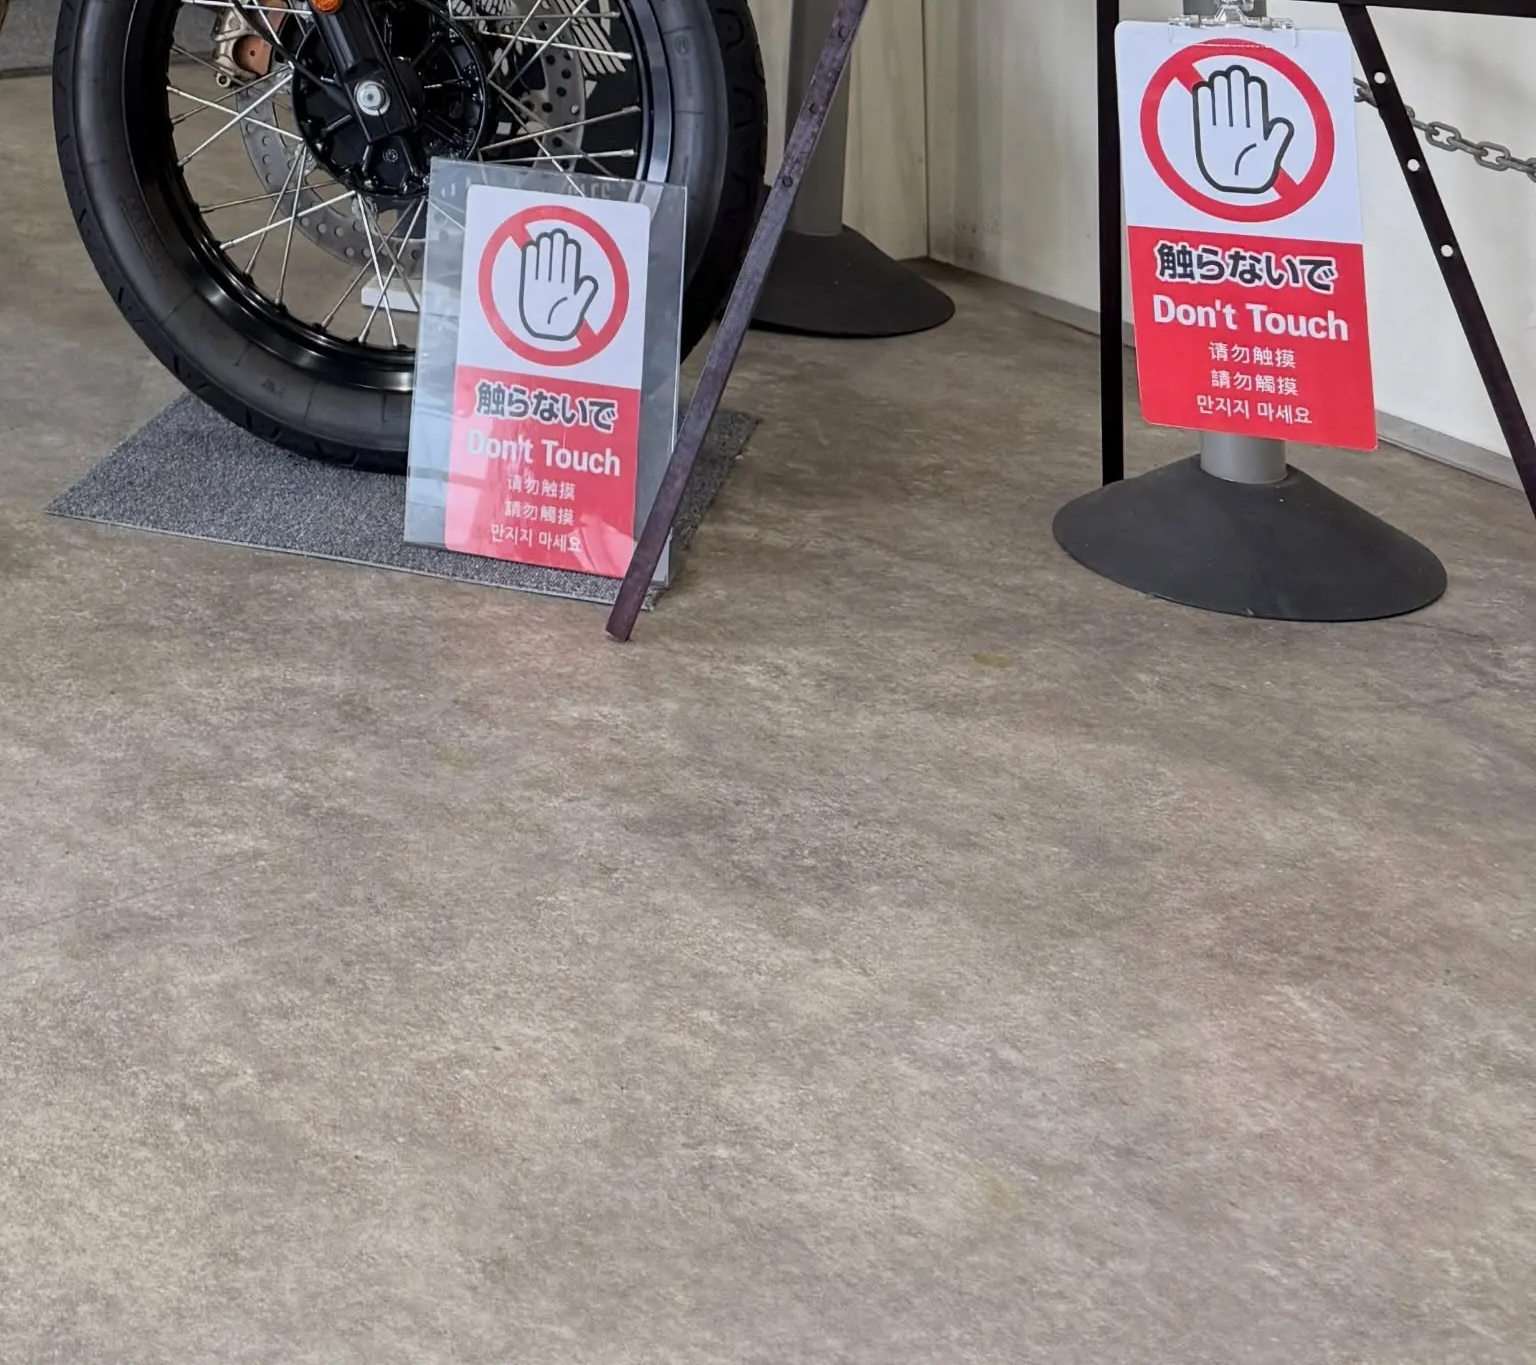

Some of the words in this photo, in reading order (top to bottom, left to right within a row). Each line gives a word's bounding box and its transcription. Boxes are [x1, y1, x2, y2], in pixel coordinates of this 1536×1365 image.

[1154, 239, 1339, 294] 触らないで
[1152, 294, 1237, 328] Don't
[1244, 303, 1349, 341] Touch
[1208, 341, 1297, 368] 请勿触摸
[1210, 369, 1299, 396] 請勿觸摸
[475, 380, 618, 433] 触らないで
[1196, 394, 1249, 420] 만지지
[1257, 401, 1313, 425] 마세요
[467, 428, 533, 465] Don't
[541, 439, 621, 476] Touch
[491, 523, 533, 548] 만지지
[538, 530, 582, 553] 마세요
